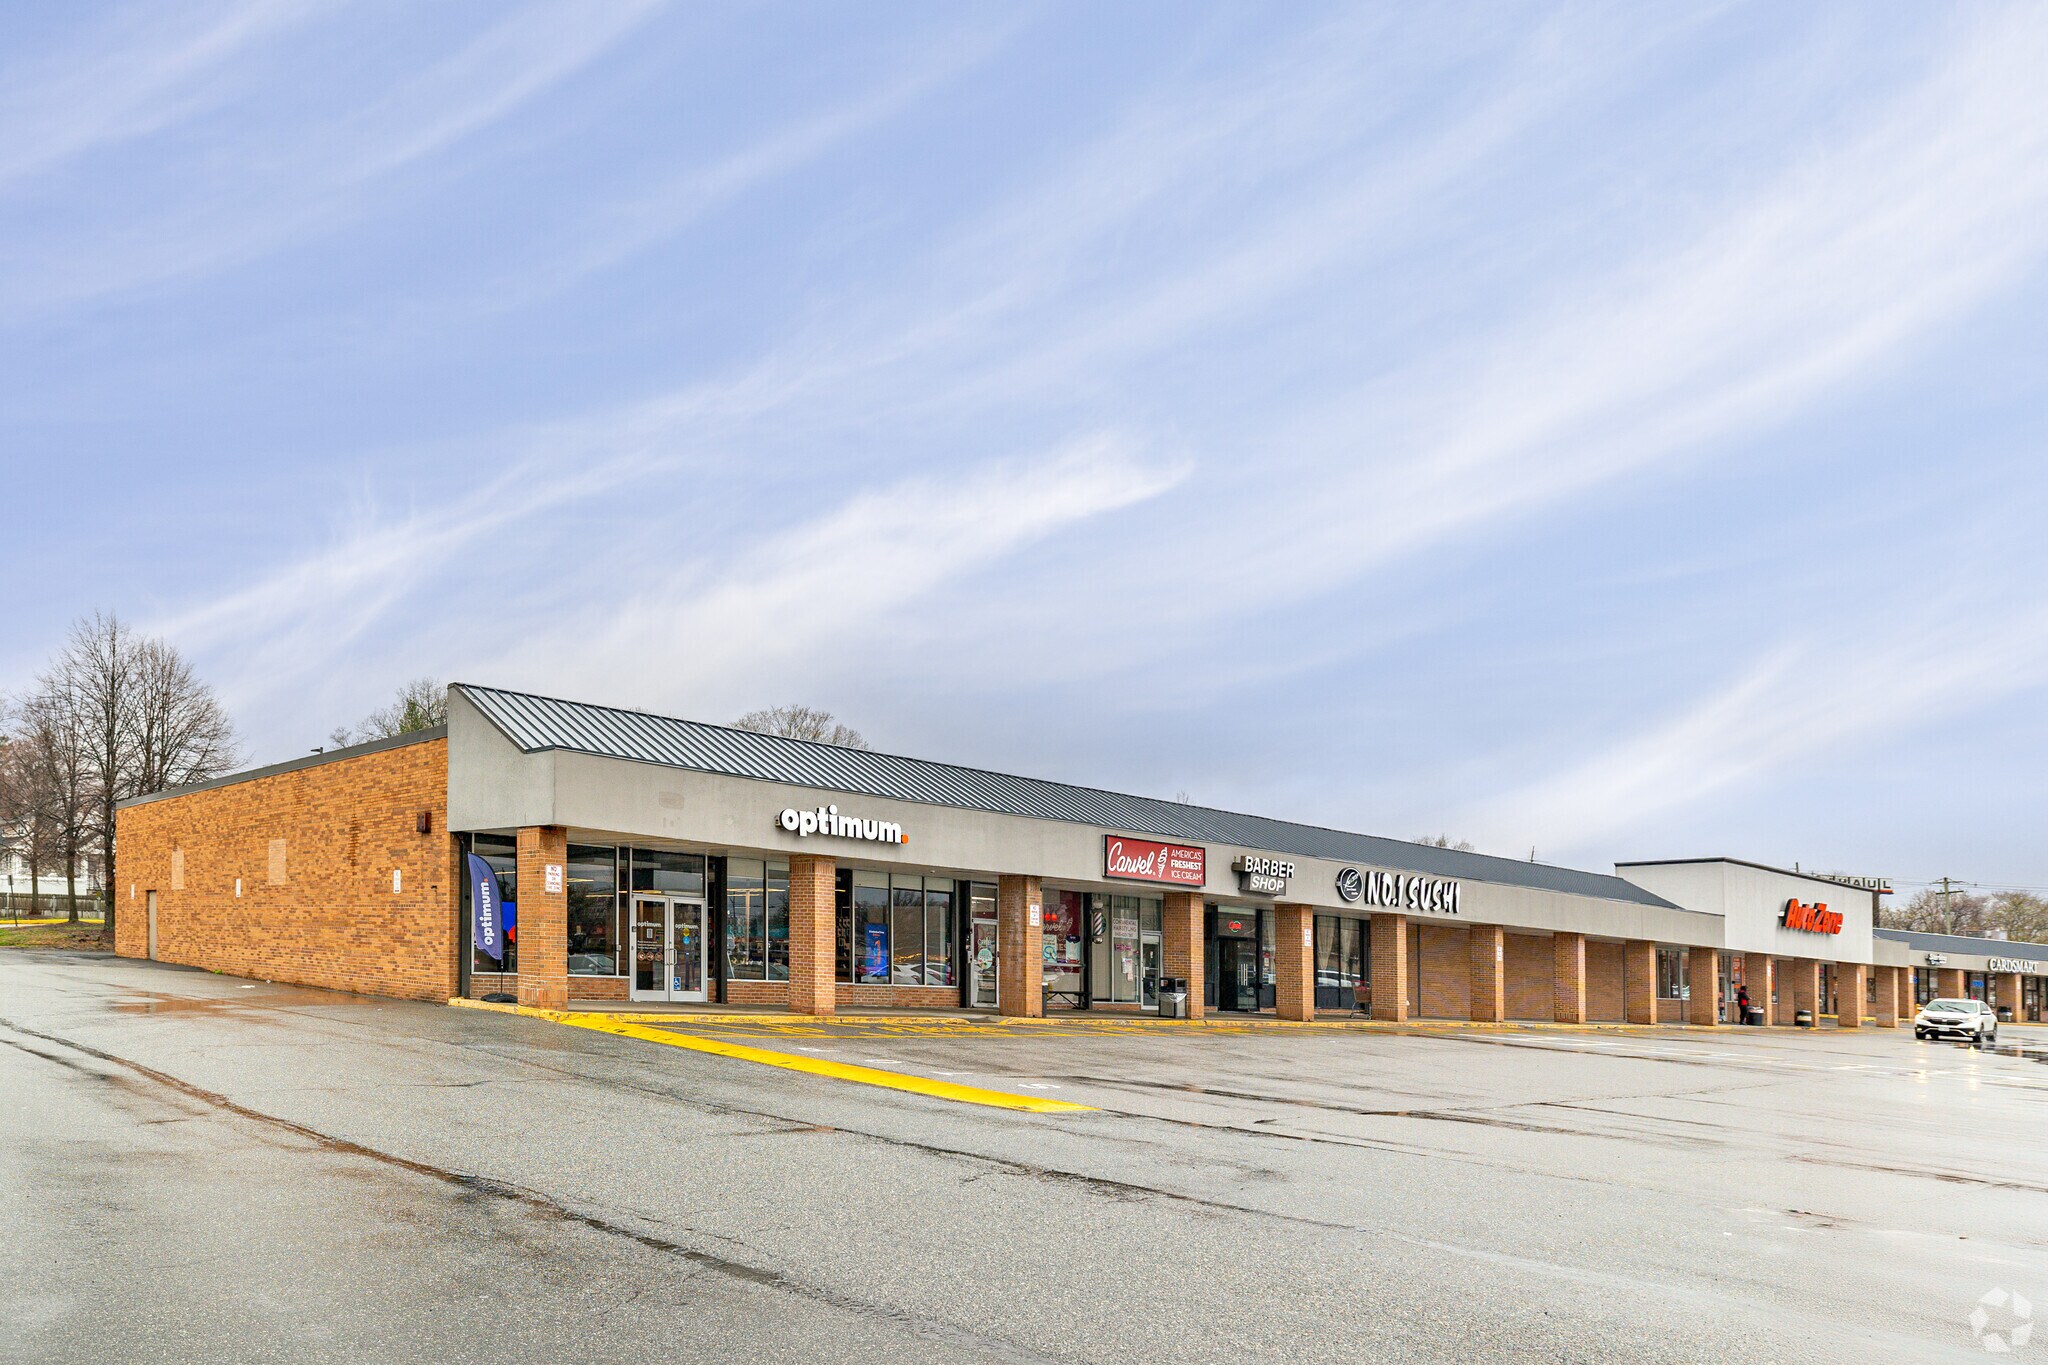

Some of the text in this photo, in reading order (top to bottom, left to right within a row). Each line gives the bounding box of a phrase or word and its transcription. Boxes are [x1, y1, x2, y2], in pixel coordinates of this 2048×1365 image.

[1171, 849, 1202, 860] AMERICA'S
[1171, 859, 1202, 871] FRESHEST
[1245, 856, 1295, 878] BARBER
[1171, 871, 1202, 881] ICE CREAM
[1251, 875, 1285, 892] SHOP
[1406, 876, 1461, 913] SUSHI
[1784, 898, 1844, 935] AutoZone
[1988, 958, 2040, 974] CARDSMART
